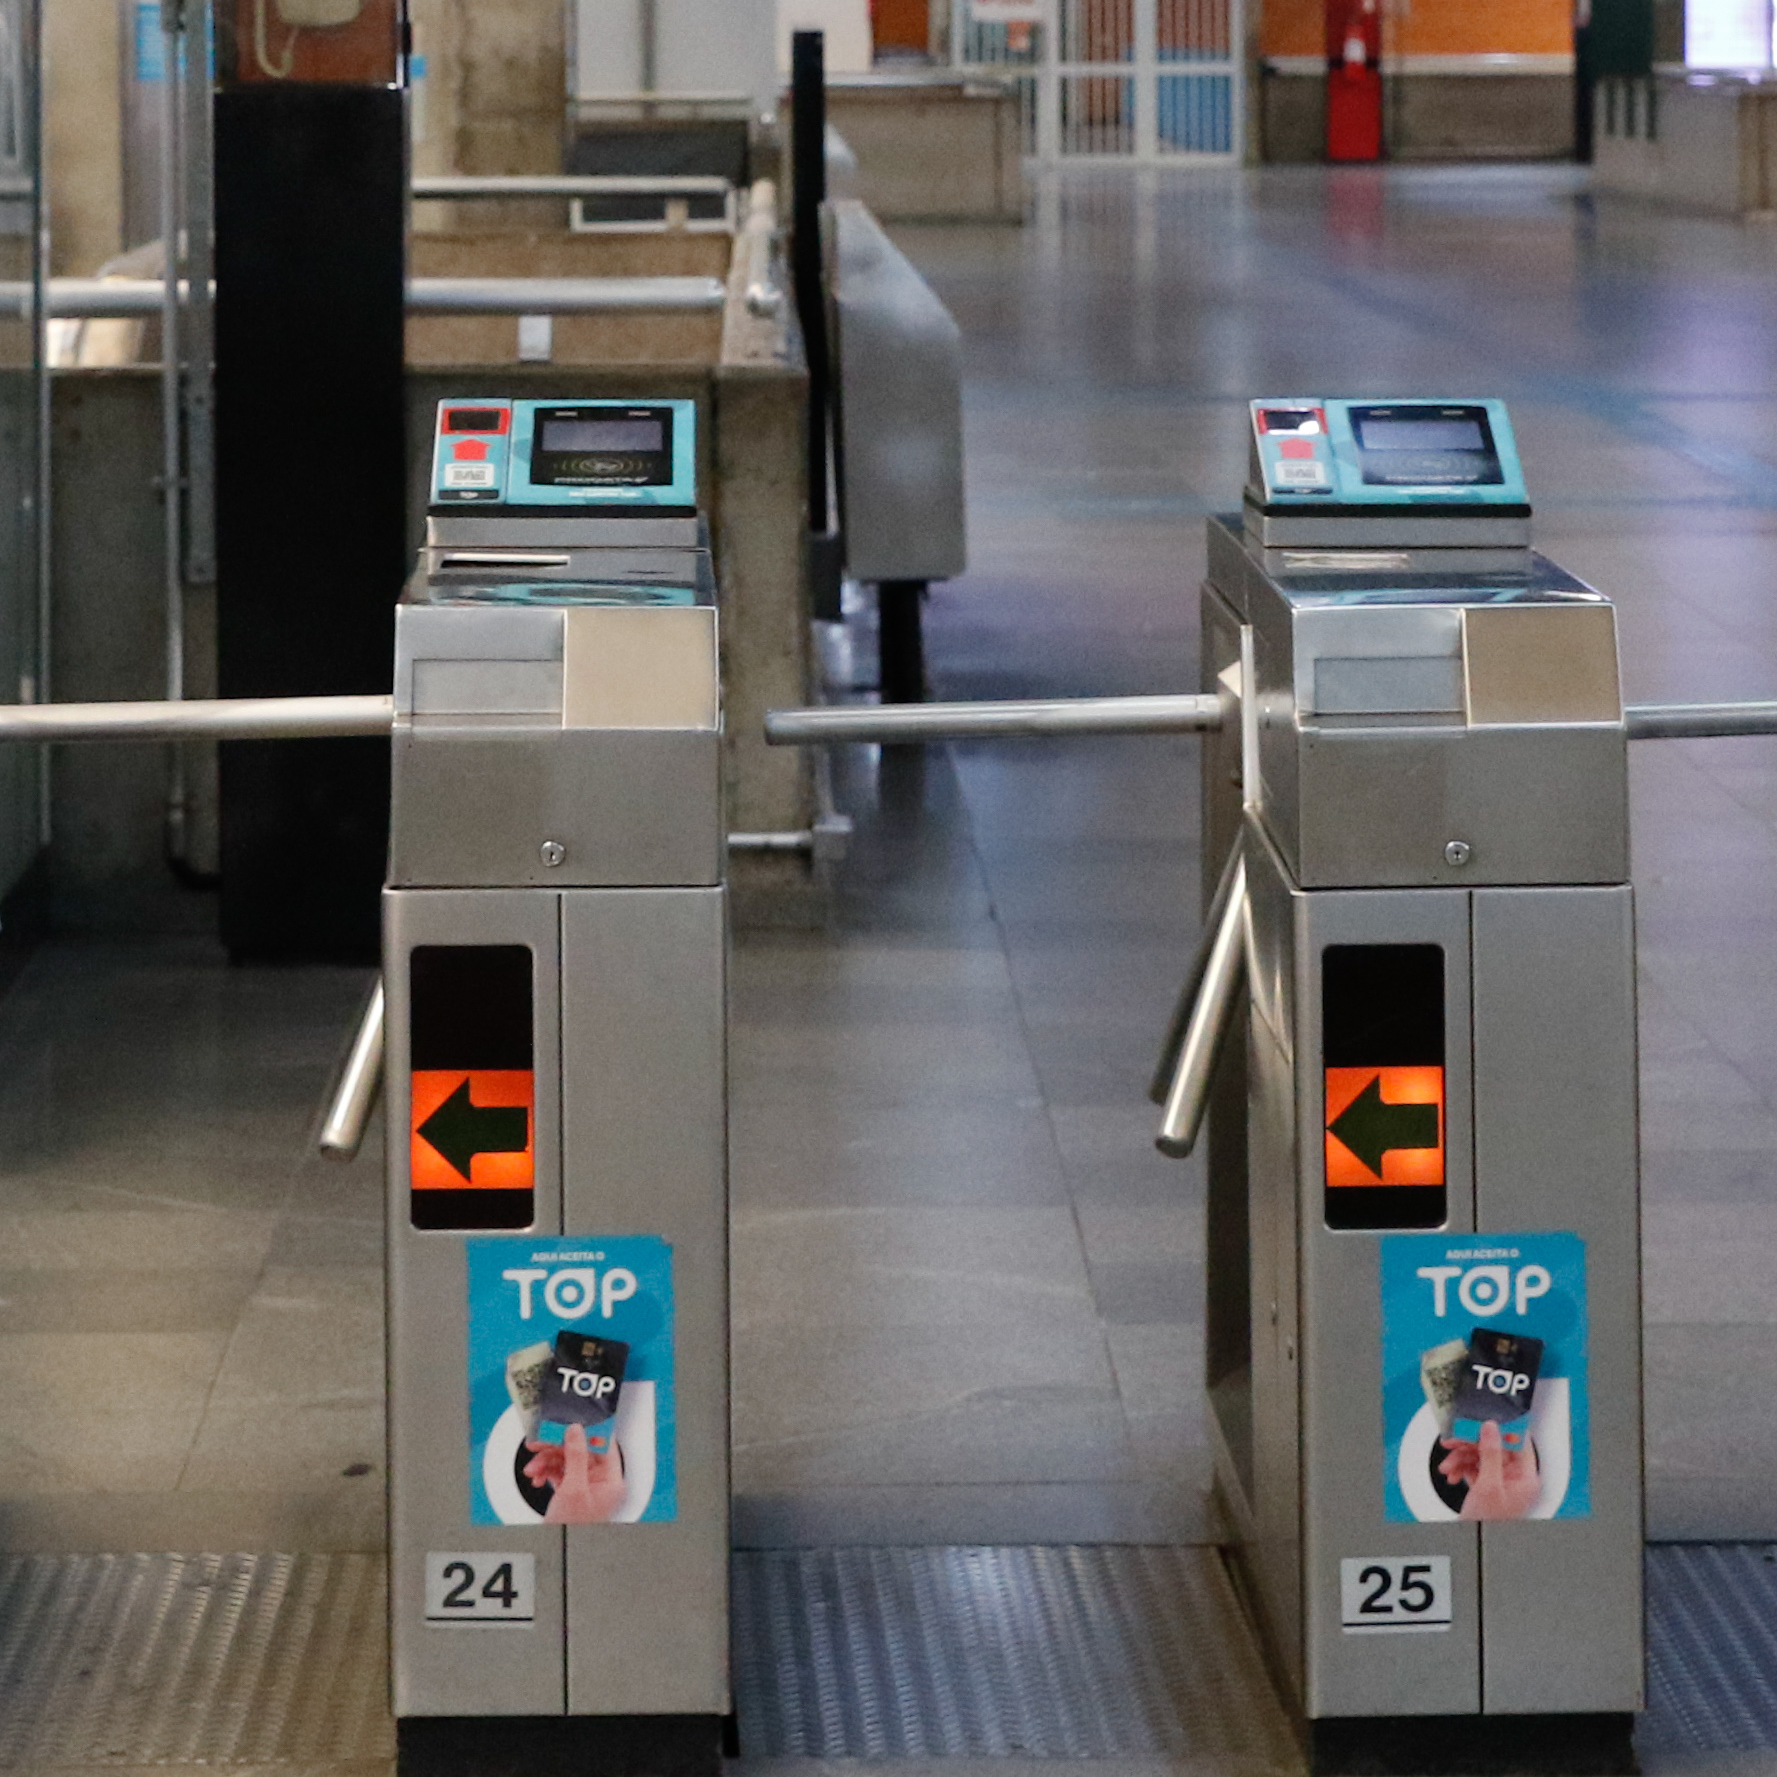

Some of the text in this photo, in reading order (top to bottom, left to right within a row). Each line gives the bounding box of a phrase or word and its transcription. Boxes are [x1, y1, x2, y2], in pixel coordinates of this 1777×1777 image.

[503, 1268, 638, 1319] TOP
[1417, 1264, 1552, 1317] TOP
[557, 1366, 615, 1399] TOP
[1472, 1364, 1530, 1396] TOP
[442, 1561, 518, 1608] 24
[1359, 1565, 1434, 1614] 25
